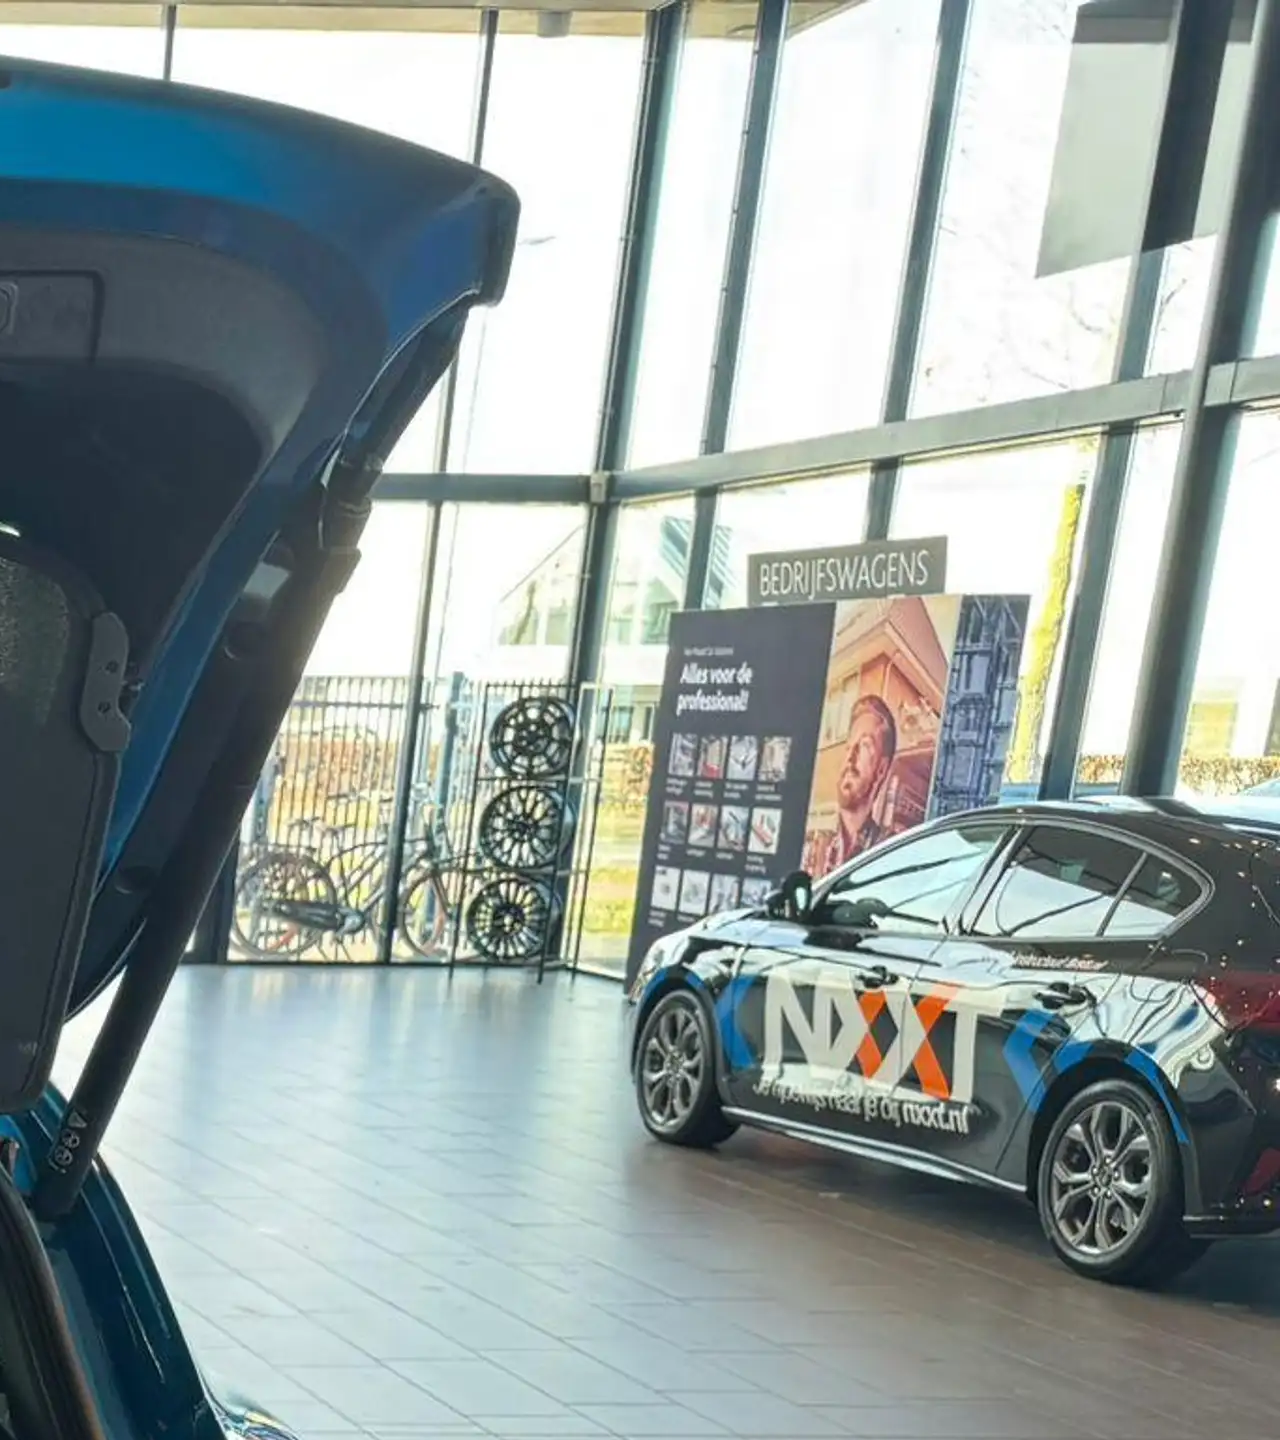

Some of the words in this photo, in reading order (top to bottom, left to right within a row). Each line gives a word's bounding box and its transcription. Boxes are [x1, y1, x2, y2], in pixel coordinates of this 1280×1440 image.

[759, 549, 930, 600] BEDRIJFSWAGENS
[680, 662, 708, 684] Alles
[710, 667, 736, 684] voor
[736, 660, 753, 684] de
[762, 965, 1004, 1103] NXXT
[902, 1103, 970, 1133] nxxt.nl
